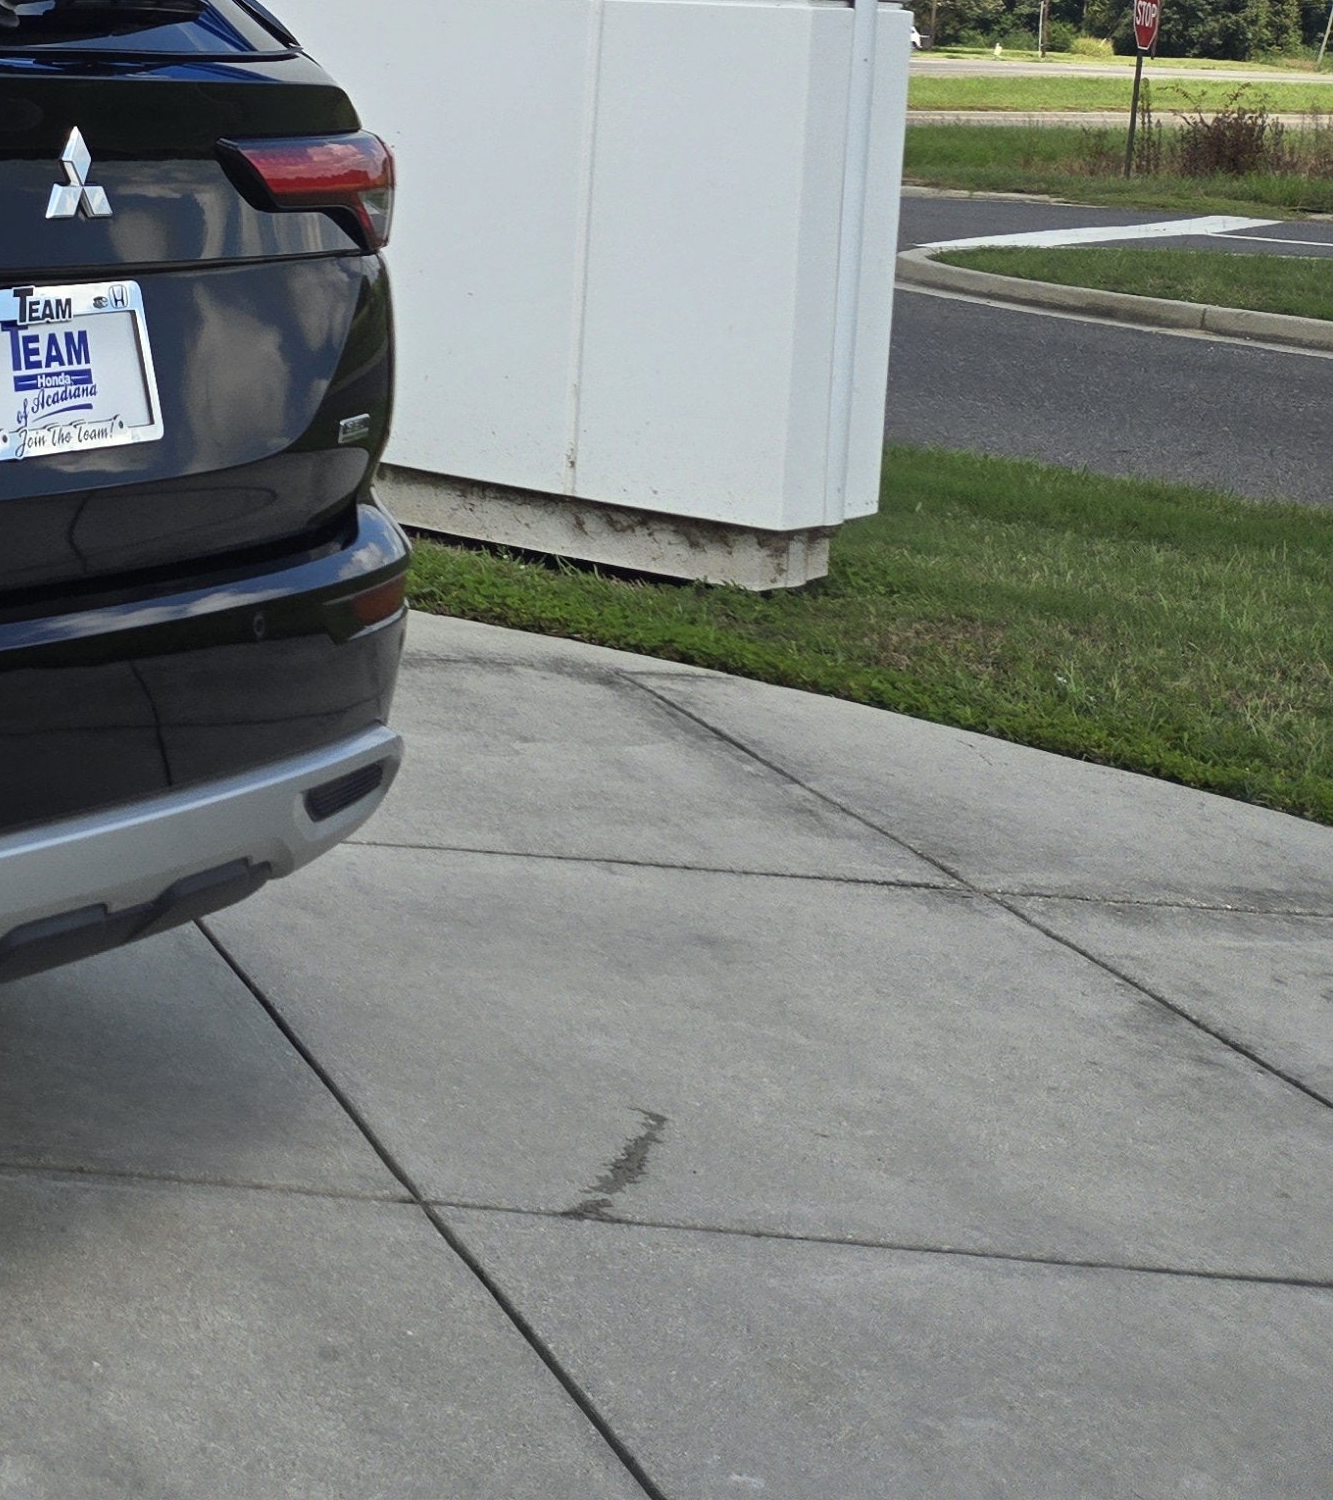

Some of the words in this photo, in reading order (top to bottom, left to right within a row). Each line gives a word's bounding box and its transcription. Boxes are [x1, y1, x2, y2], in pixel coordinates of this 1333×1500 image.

[1135, 0, 1157, 27] STOP
[13, 287, 72, 323] TEAM
[1, 322, 91, 371] TEAM
[37, 372, 71, 388] Honda
[16, 398, 29, 428] of
[31, 383, 98, 414] Acadiana
[15, 429, 46, 457] Join
[47, 424, 72, 447] The
[73, 420, 115, 442] Team!
